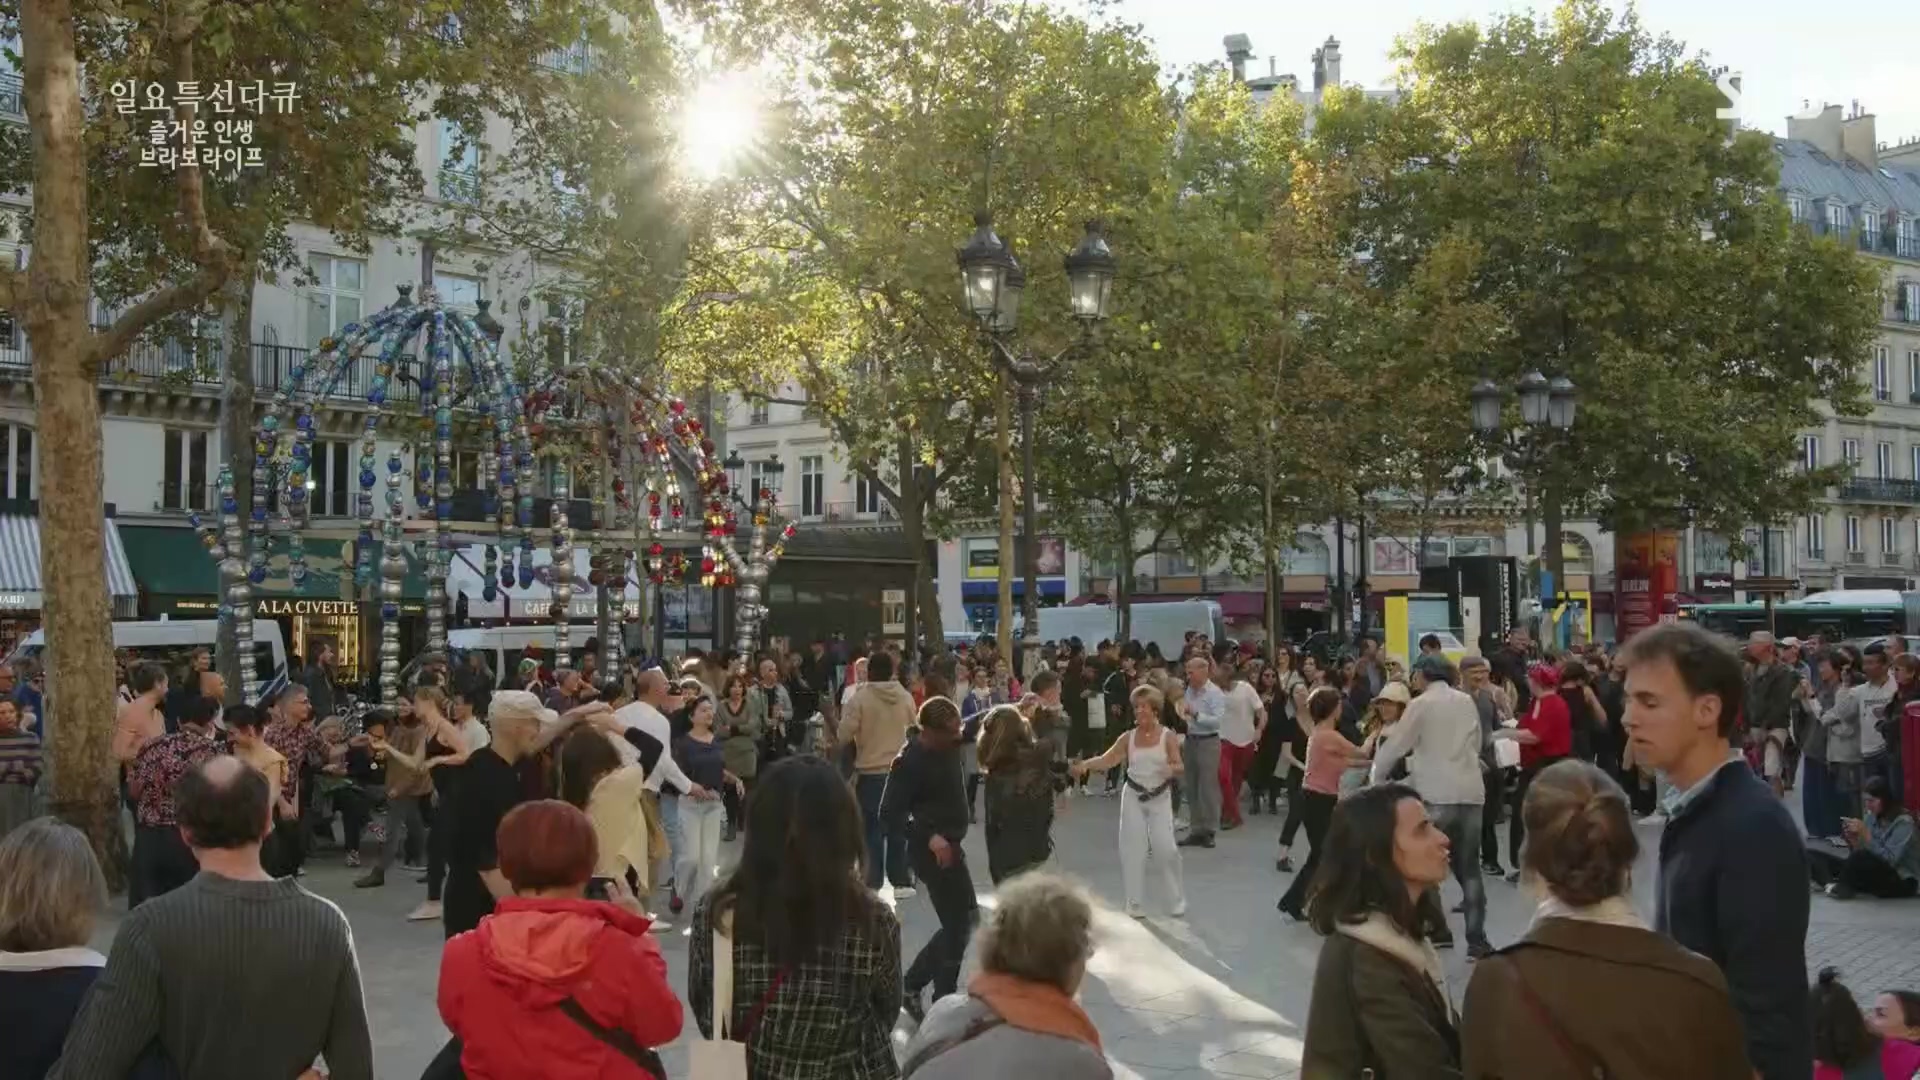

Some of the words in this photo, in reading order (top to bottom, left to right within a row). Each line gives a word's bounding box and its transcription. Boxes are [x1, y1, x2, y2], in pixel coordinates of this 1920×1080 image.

[257, 600, 269, 613] A
[271, 600, 292, 613] LA
[295, 600, 359, 614] CIVETTE
